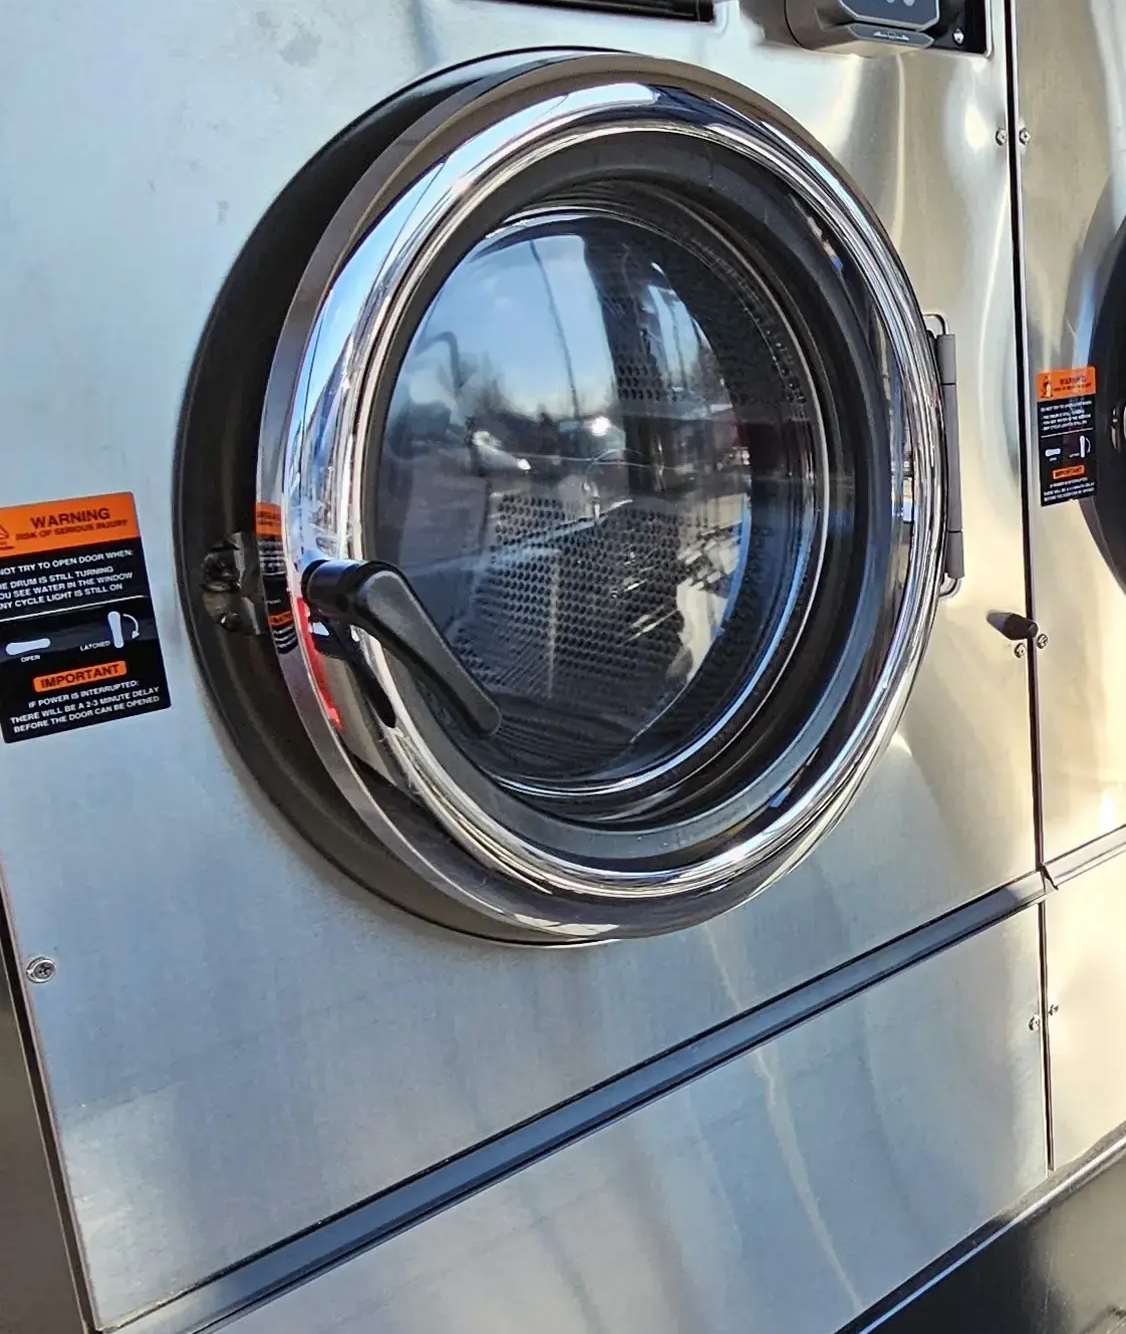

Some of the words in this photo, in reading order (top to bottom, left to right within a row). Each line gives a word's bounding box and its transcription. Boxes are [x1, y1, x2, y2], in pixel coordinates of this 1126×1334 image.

[30, 508, 110, 529] WARNING
[40, 529, 52, 538] OF
[54, 524, 95, 535] SERIOUS
[18, 563, 36, 573] TRY
[37, 561, 50, 570] TO
[52, 557, 77, 567] OPEN
[79, 554, 105, 564] DOOR
[10, 578, 37, 589] DRUM
[39, 576, 48, 584] IS
[49, 572, 74, 583] STILL
[75, 566, 114, 578] TURNING
[13, 588, 31, 598] SEE
[33, 584, 65, 595] WATER
[78, 578, 96, 587] THE
[97, 572, 133, 584] WINDOW
[15, 596, 45, 607] CYCLE
[46, 591, 72, 602] LIGHT
[74, 589, 83, 597] IS
[84, 586, 108, 596] STILL
[109, 583, 123, 592] ON
[79, 640, 111, 652] LATCHED
[20, 654, 41, 663] OPEN
[41, 664, 120, 688] IMPORTANT
[10, 711, 41, 725] THERE
[41, 707, 63, 718] WILL
[64, 703, 77, 712] BE
[78, 702, 85, 710] A
[86, 699, 99, 709] 2-3
[99, 692, 131, 706] MINUTE
[131, 686, 160, 699] DELAY
[28, 700, 37, 709] IF
[38, 694, 70, 707] POWER
[71, 691, 80, 700] IS
[80, 680, 140, 699] INTERRUPTED:
[13, 719, 50, 734] BEFORE
[50, 715, 68, 726] THE
[69, 709, 95, 722] DOOR
[95, 705, 114, 716] CAN
[113, 702, 126, 712] BE
[126, 695, 160, 709] OPENED
